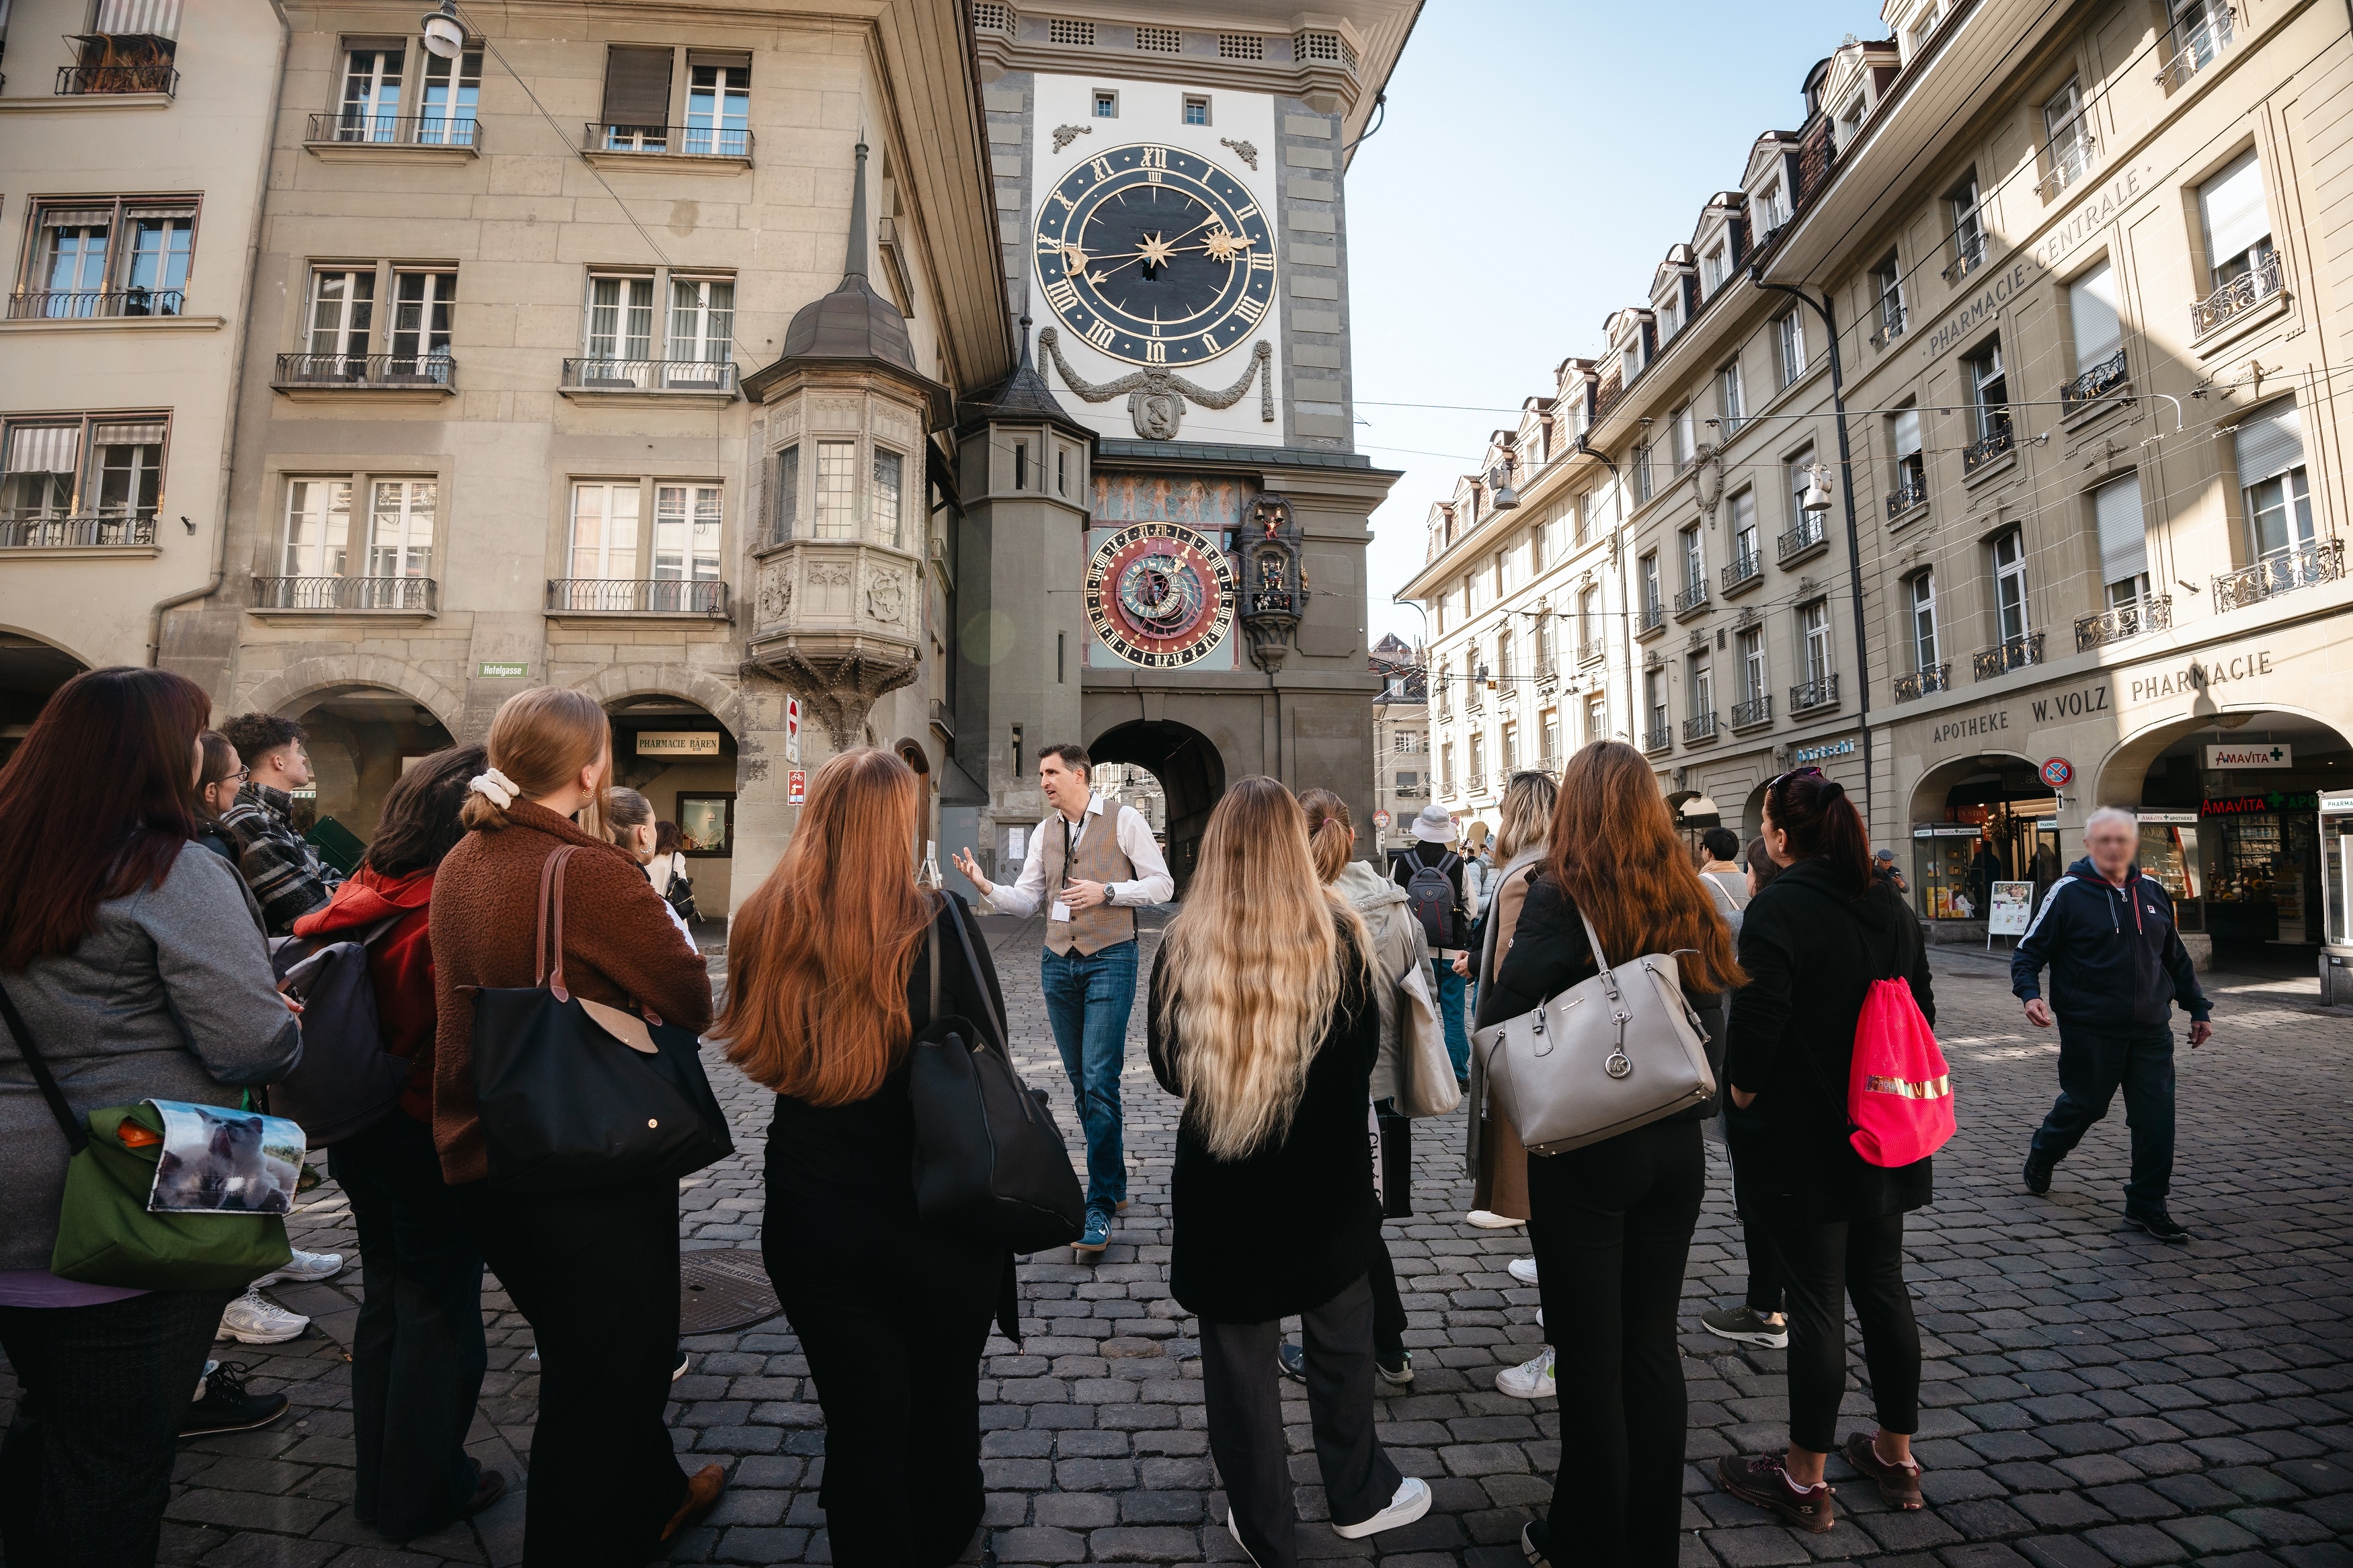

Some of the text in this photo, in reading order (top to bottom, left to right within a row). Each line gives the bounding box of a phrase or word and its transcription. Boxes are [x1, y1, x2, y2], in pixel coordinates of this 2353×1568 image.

[1140, 147, 1167, 169] XII
[1090, 157, 1114, 181] XI
[1201, 167, 1214, 184] I
[1053, 190, 1074, 211] X
[1236, 203, 1258, 221] II
[1037, 233, 1061, 255] IX
[1251, 253, 1274, 272] III
[483, 665, 522, 677] Hotelgasse
[2131, 650, 2272, 701] PHARMACIE
[1933, 711, 2009, 743] APOTHEKE
[639, 737, 717, 748] PHARMACIE BÄREN
[1607, 1059, 1627, 1072] MK
